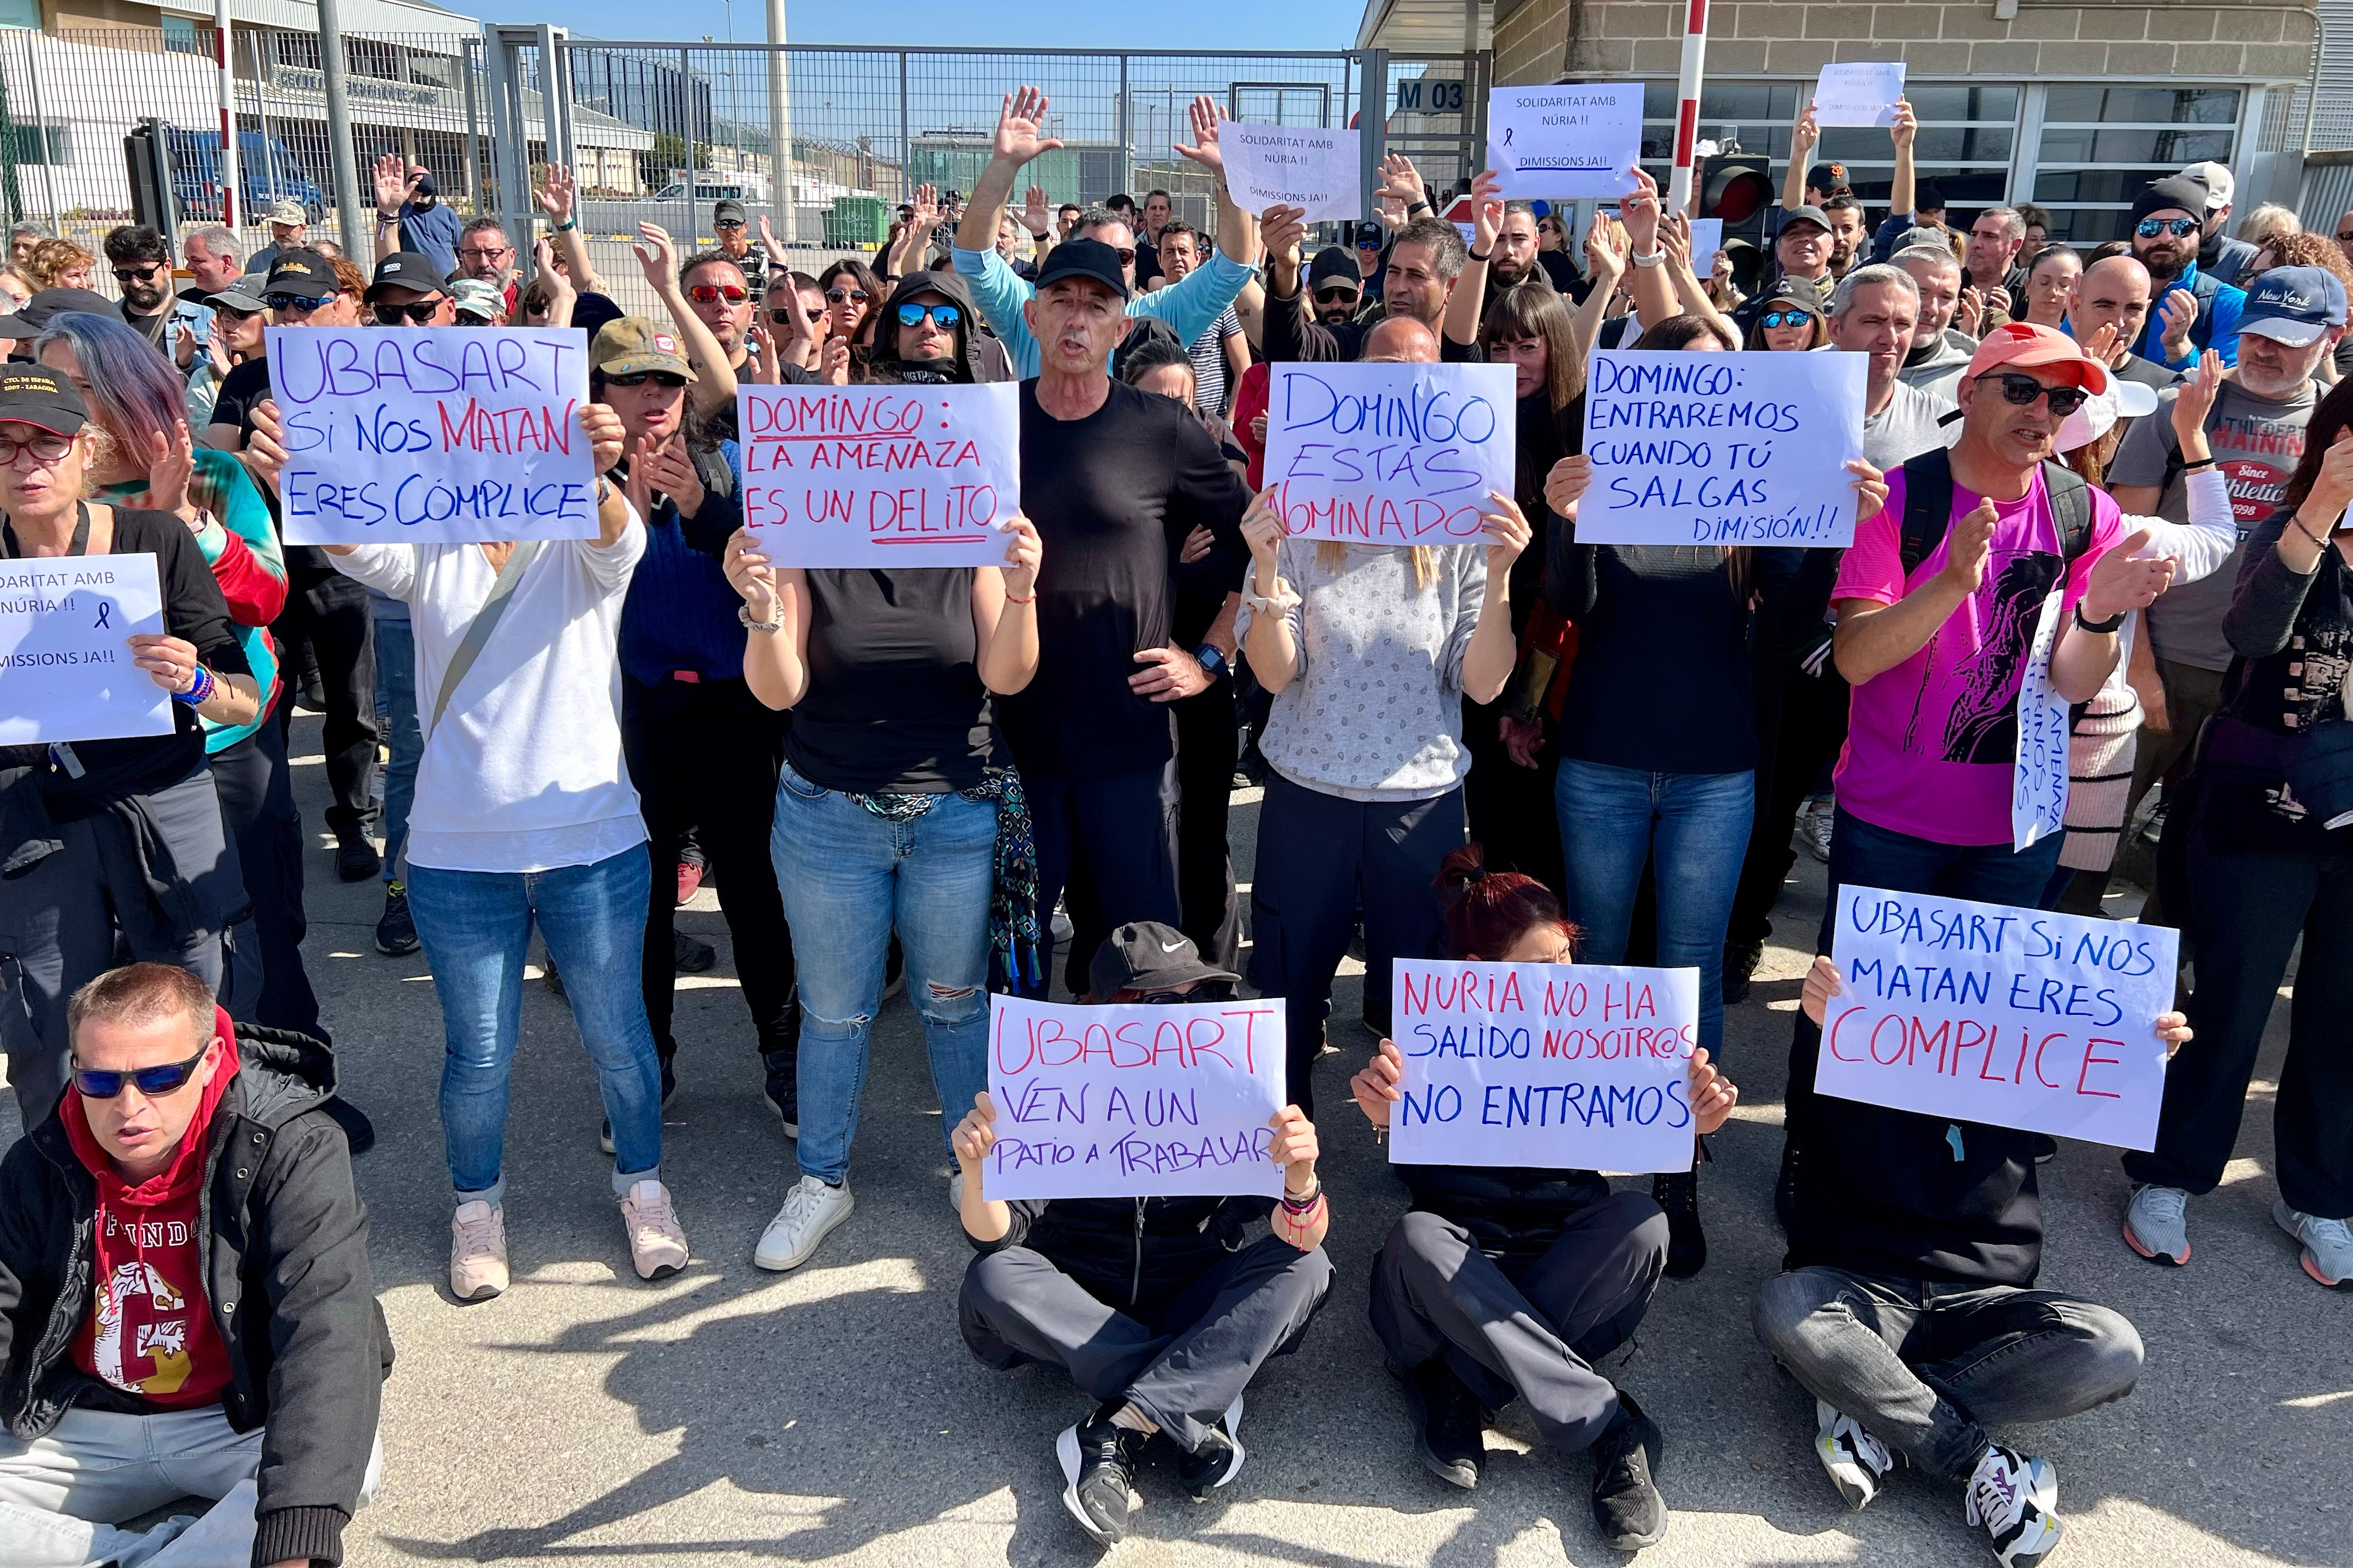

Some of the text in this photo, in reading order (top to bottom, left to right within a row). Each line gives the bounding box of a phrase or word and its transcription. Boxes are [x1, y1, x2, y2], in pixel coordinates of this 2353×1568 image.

[1399, 83, 1463, 109] M 03
[1516, 96, 1616, 108] SOLIDARITAT AMB
[1542, 113, 1577, 125] NÚRIA
[1240, 134, 1333, 149] SOLIDARITAT AMB
[1265, 152, 1297, 165] NÚRIA
[1520, 156, 1607, 167] DIMISSIONS JA!!
[1250, 186, 1327, 202] DIMISSIONS JA!!
[2257, 289, 2310, 306] New York
[2277, 336, 2310, 345] NEW YORK
[278, 337, 574, 404] UBASART
[1595, 357, 1745, 396] DOMINGO:
[25, 385, 59, 393] ZARAGOZA
[1283, 373, 1496, 443] DOMINGO
[1591, 399, 1798, 432] ENTRAREMOS
[284, 397, 577, 456] Si NOS MATAN
[748, 440, 981, 473] LA AMENAZA
[1287, 444, 1482, 496] ESTÁS
[1589, 441, 1772, 470] CUANDO TÚ
[2239, 465, 2268, 479] Since
[290, 472, 387, 526] ERES
[1609, 476, 1767, 508] SALGAS
[2226, 479, 2284, 502] hletic
[746, 485, 998, 532] ES UN DELITO
[1268, 480, 1483, 540] NOMINADO
[1694, 504, 1838, 541] DIMISIÓN!!
[74, 572, 114, 585] AMB
[1, 598, 58, 613] NÚRIA
[2047, 707, 2063, 833] AMENAZA
[2036, 804, 2045, 819] E
[1852, 895, 2155, 976] UBASART Si NOS
[1404, 970, 1656, 1022] NURIA NO HA
[1852, 958, 2122, 1026] MATAN ERES
[997, 1007, 1274, 1074] UBASART
[1407, 1022, 1695, 1060] SALIDO NOSOTR@S
[1830, 1005, 2125, 1099] COMPLICE
[1001, 1077, 1198, 1126] VEN A UN
[1403, 1080, 1689, 1128] NO ENTRAMOS
[991, 1137, 1074, 1175] PATIO
[1086, 1144, 1099, 1164] A
